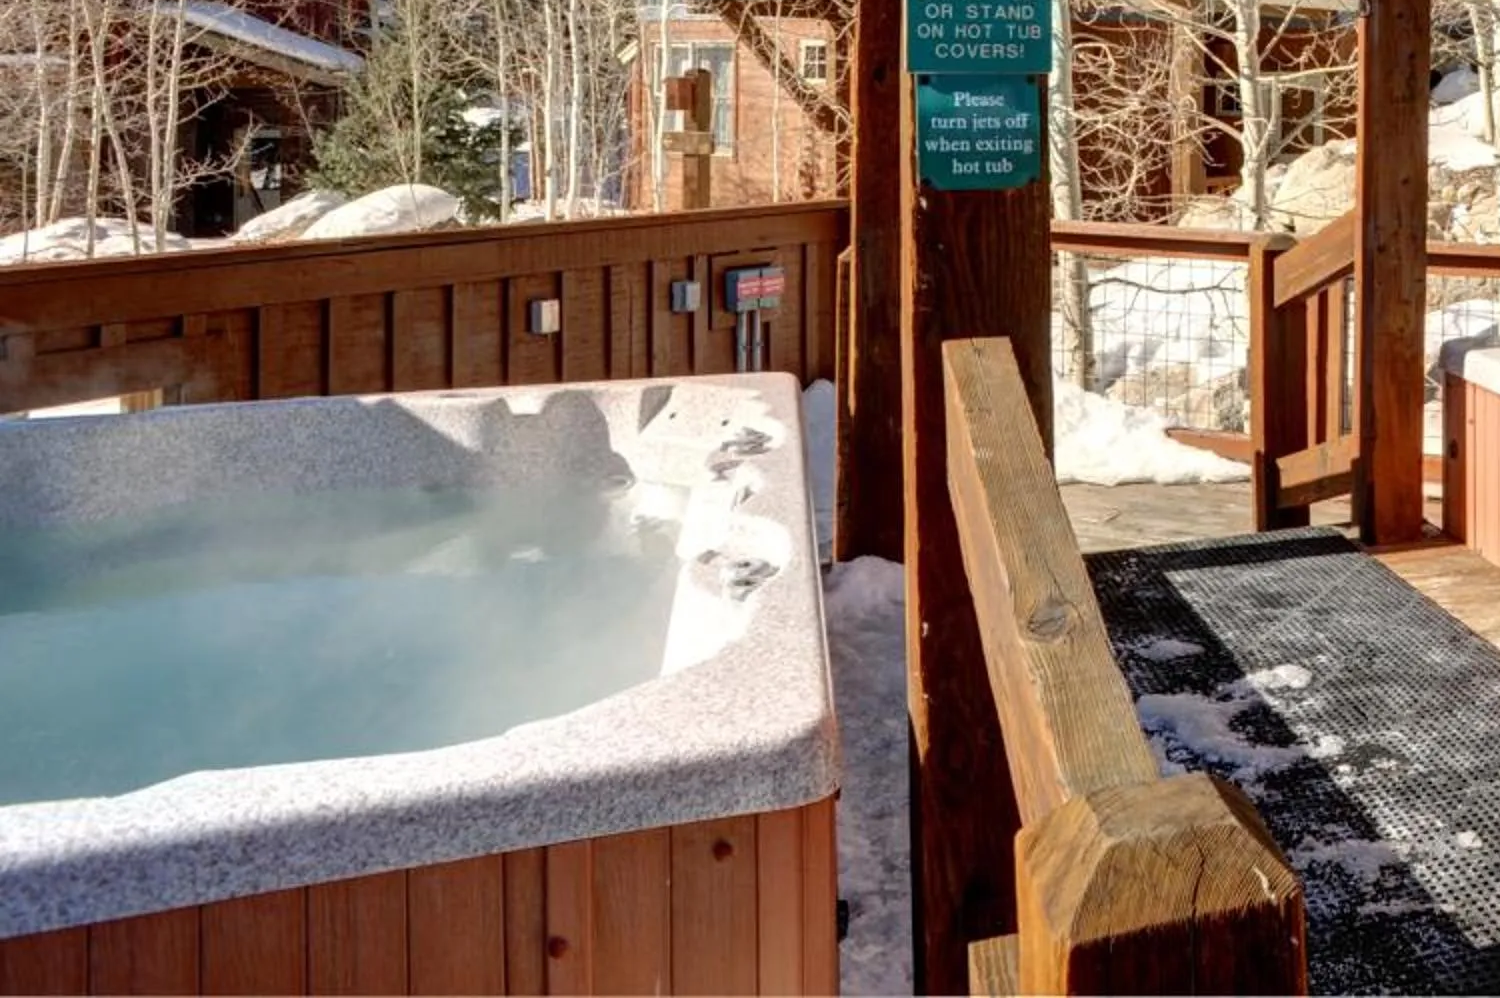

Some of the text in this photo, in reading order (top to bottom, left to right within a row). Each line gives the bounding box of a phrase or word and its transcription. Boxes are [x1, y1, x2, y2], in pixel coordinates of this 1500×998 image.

[925, 4, 1035, 20] OR STAND
[917, 24, 1041, 39] ON HOT TUB
[935, 44, 1024, 59] COVERS!
[953, 91, 1005, 106] Please
[931, 113, 1031, 131] turn jets off
[925, 136, 1034, 153] when exiting
[952, 158, 1013, 174] hot tub
